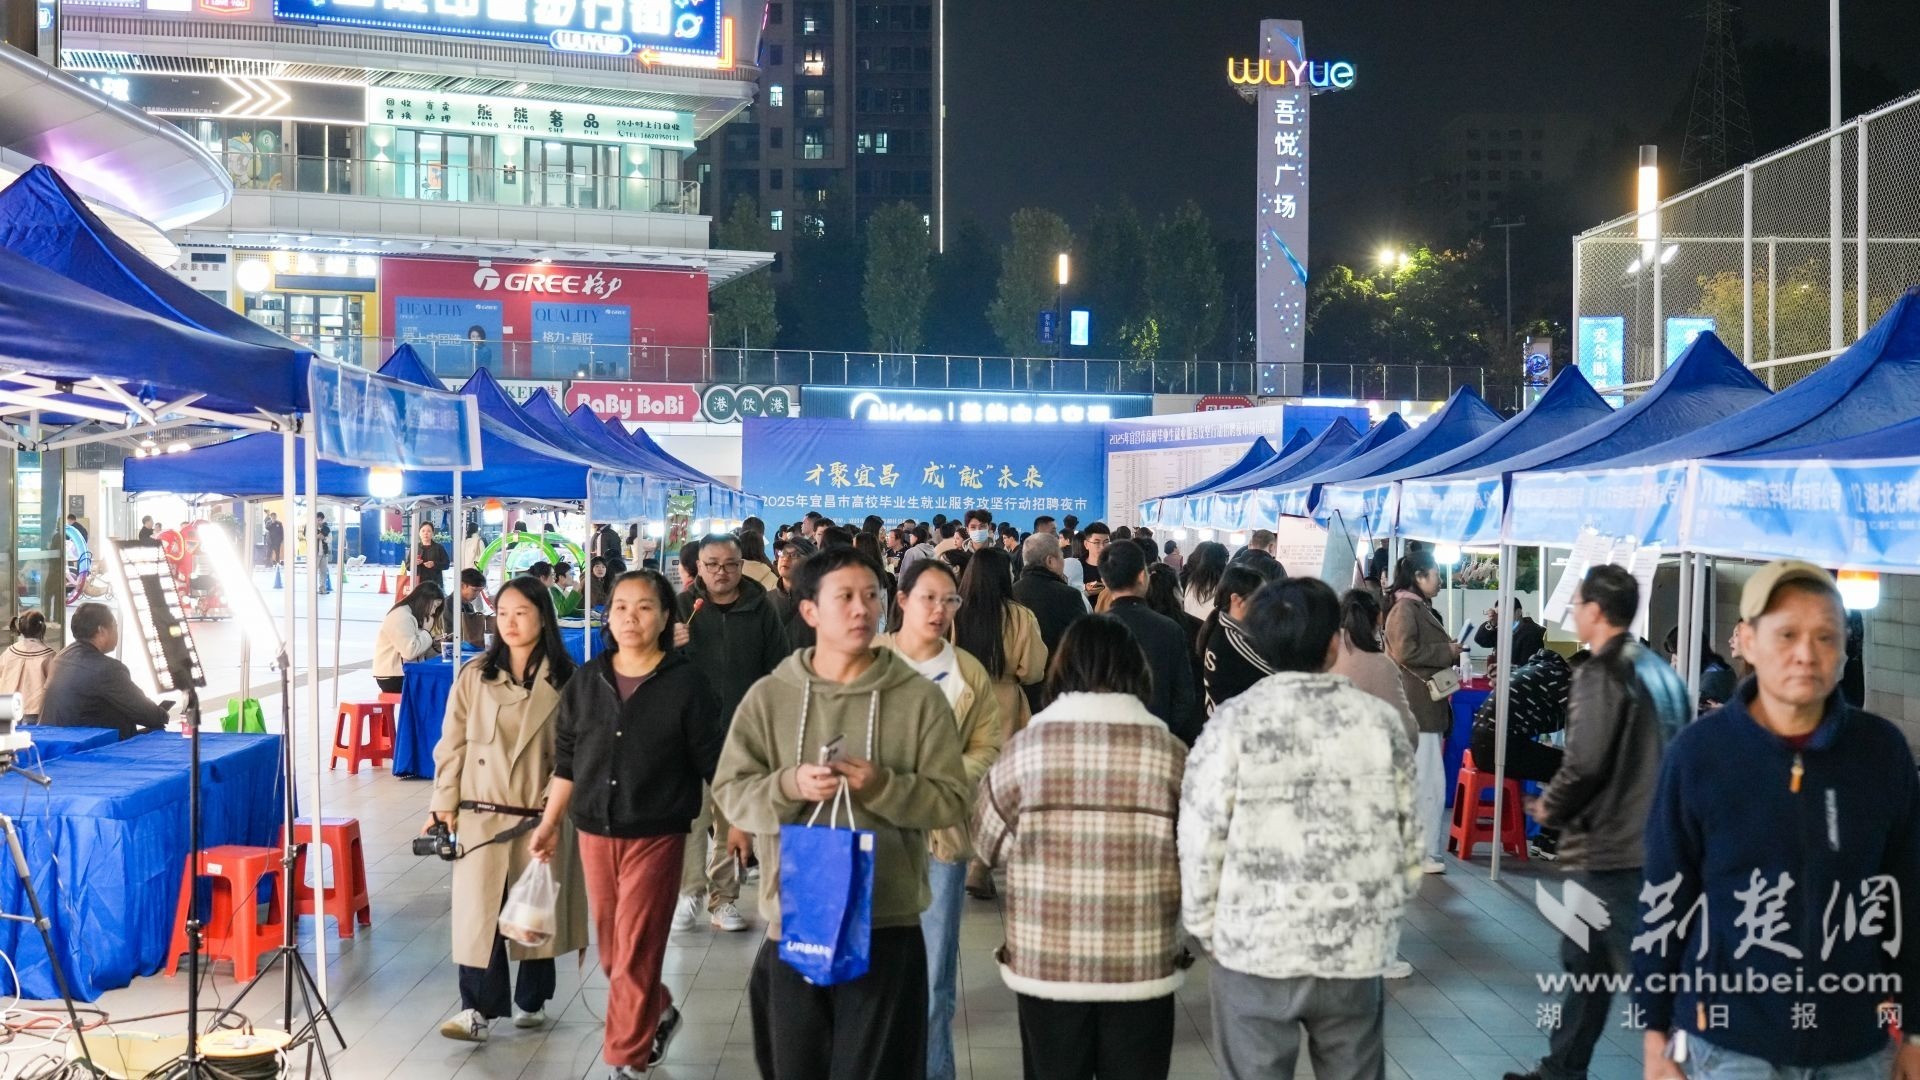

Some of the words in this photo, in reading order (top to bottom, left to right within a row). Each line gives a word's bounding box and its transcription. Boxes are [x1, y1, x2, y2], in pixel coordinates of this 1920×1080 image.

[425, 113, 451, 123] 护理
[616, 119, 680, 131] 24小时上门回收
[1274, 100, 1297, 219] 吾悦广场
[504, 273, 581, 293] GREE
[581, 271, 622, 300] 格力
[400, 302, 464, 317] HEALTHY
[535, 308, 600, 323] QUALITY
[713, 396, 785, 413] 港饮港
[805, 461, 900, 488] 才聚宜昌
[762, 494, 1088, 512] 2025年宜昌市高校毕业生就业服务攻坚行动招聘夜市
